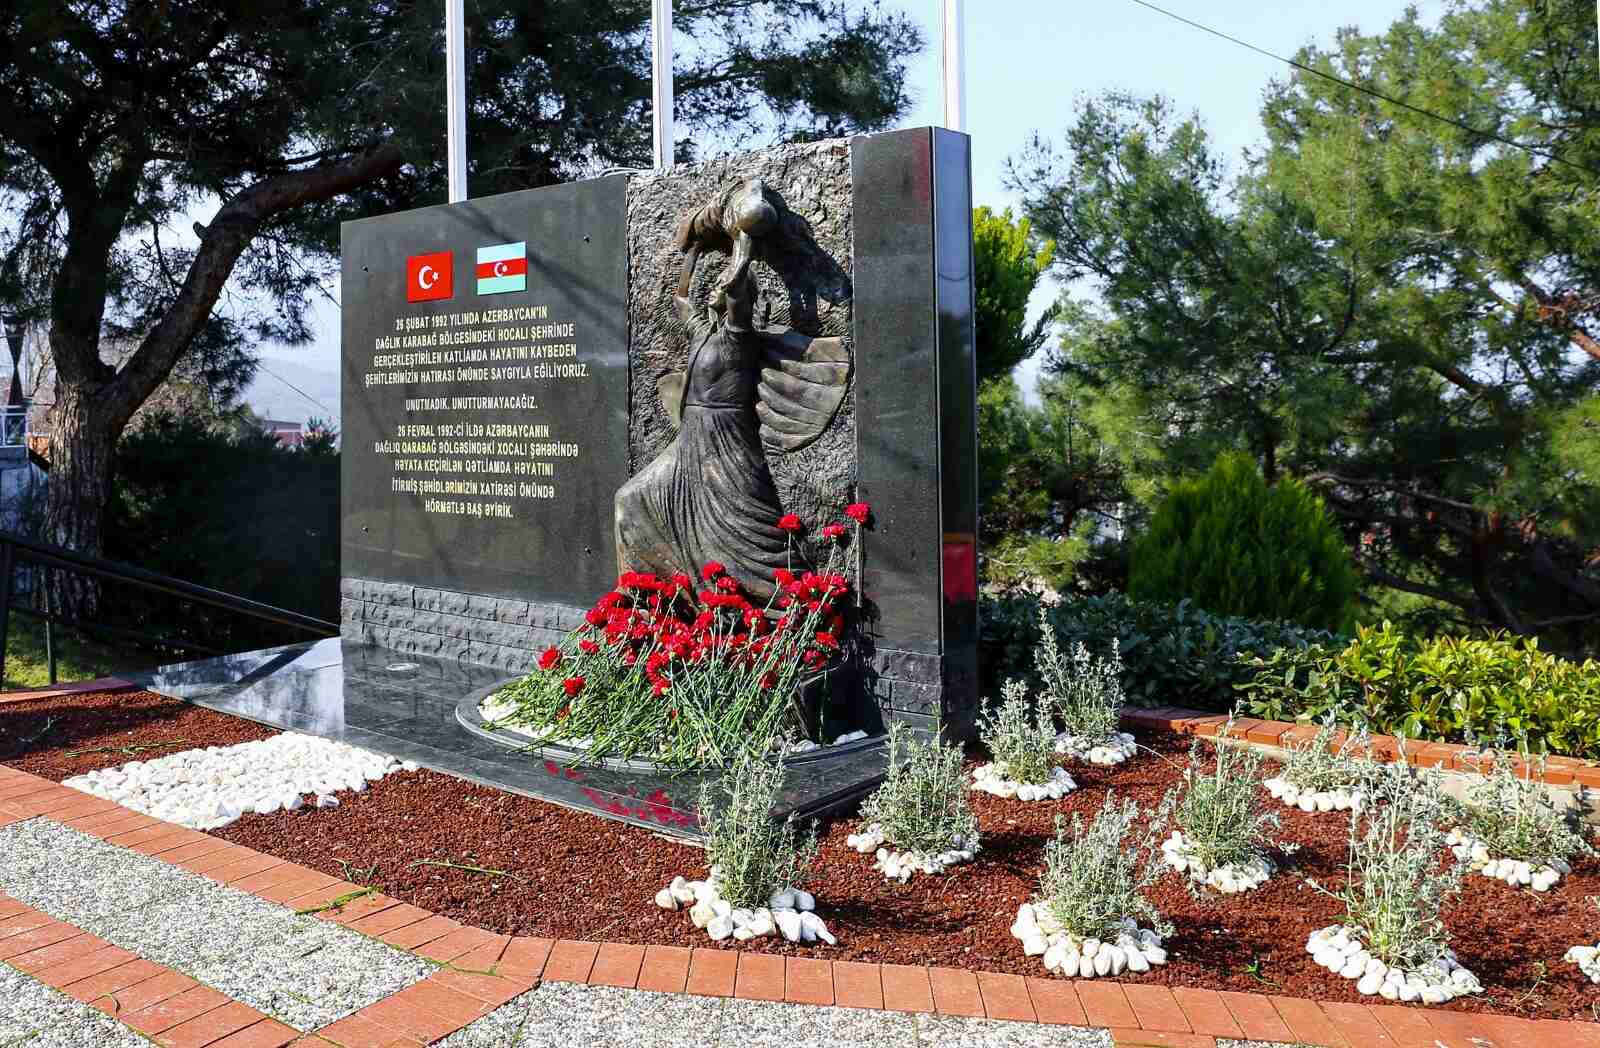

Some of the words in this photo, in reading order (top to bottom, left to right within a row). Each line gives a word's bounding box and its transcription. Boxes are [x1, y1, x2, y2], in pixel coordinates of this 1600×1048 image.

[406, 316, 428, 332] ŞUBAT
[432, 314, 448, 328] 1992
[450, 311, 480, 326] YILINDA
[376, 335, 400, 350] DAĞLIK
[403, 332, 437, 347] KARABAĞ
[440, 327, 496, 344] BÖLGESİNDEKİ
[531, 321, 574, 339] ŞEHRİNDE
[374, 347, 442, 368] GERÇEKLEŞTİRİLEN
[444, 347, 488, 363] KATLİAMDA
[490, 346, 528, 359] HAYATINI
[530, 344, 576, 358] KAYBEDEN
[365, 367, 418, 388] ŞEHİTLERİMİZİN
[421, 367, 454, 382] HATIRASI
[457, 364, 489, 381] ÖNÜNDE
[534, 361, 589, 378] EĞİLİYORUZ.
[406, 398, 450, 410] UNUTMADIK.
[452, 394, 538, 409] UNUTTURMAYACAĞIZ.
[398, 426, 406, 436] 26
[408, 425, 435, 437] FEVRAL
[438, 422, 463, 437] 1992-Cİ
[466, 422, 483, 436] İLDƏ
[486, 425, 549, 437] AZƏRBAYCANIN
[375, 440, 400, 453] DAĞLIQ
[402, 440, 437, 453] QARABAĞ
[497, 443, 528, 455] XOCALI
[530, 441, 578, 459] ŞƏHƏRİNDƏ
[395, 459, 422, 470] HƏYATA
[425, 457, 463, 475] KEÇİRİLƏN
[465, 458, 511, 474] QƏTLİAMDA
[514, 462, 553, 476] HƏYATINI
[392, 477, 417, 494] İTİRMİŞ
[419, 478, 477, 494] ŞƏHİDLƏRİMİZİN
[480, 481, 517, 497] XATİRƏSİ
[520, 481, 554, 498] ÖNÜNDƏ
[425, 499, 465, 514] HÖRMƏTLƏ
[467, 501, 482, 518] BAŞ
[485, 501, 513, 518] ƏYİRİK.
